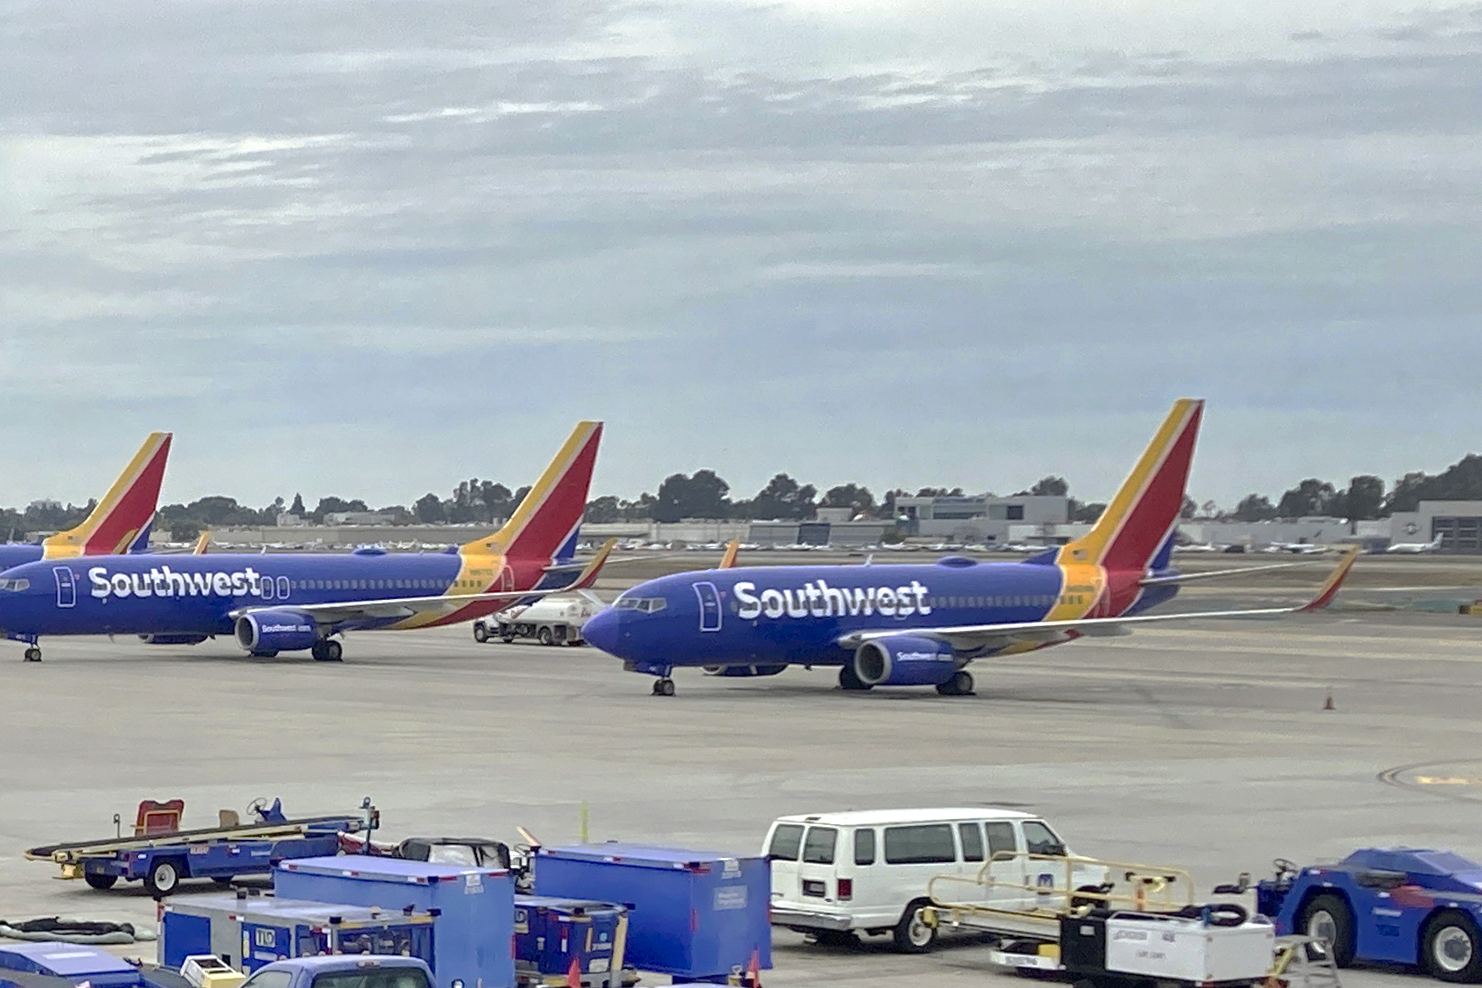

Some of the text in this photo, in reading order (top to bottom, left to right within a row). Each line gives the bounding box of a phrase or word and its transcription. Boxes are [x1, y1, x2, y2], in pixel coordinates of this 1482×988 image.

[89, 565, 261, 598] Southwest
[733, 579, 932, 620] Southwest
[256, 929, 275, 947] TLD
